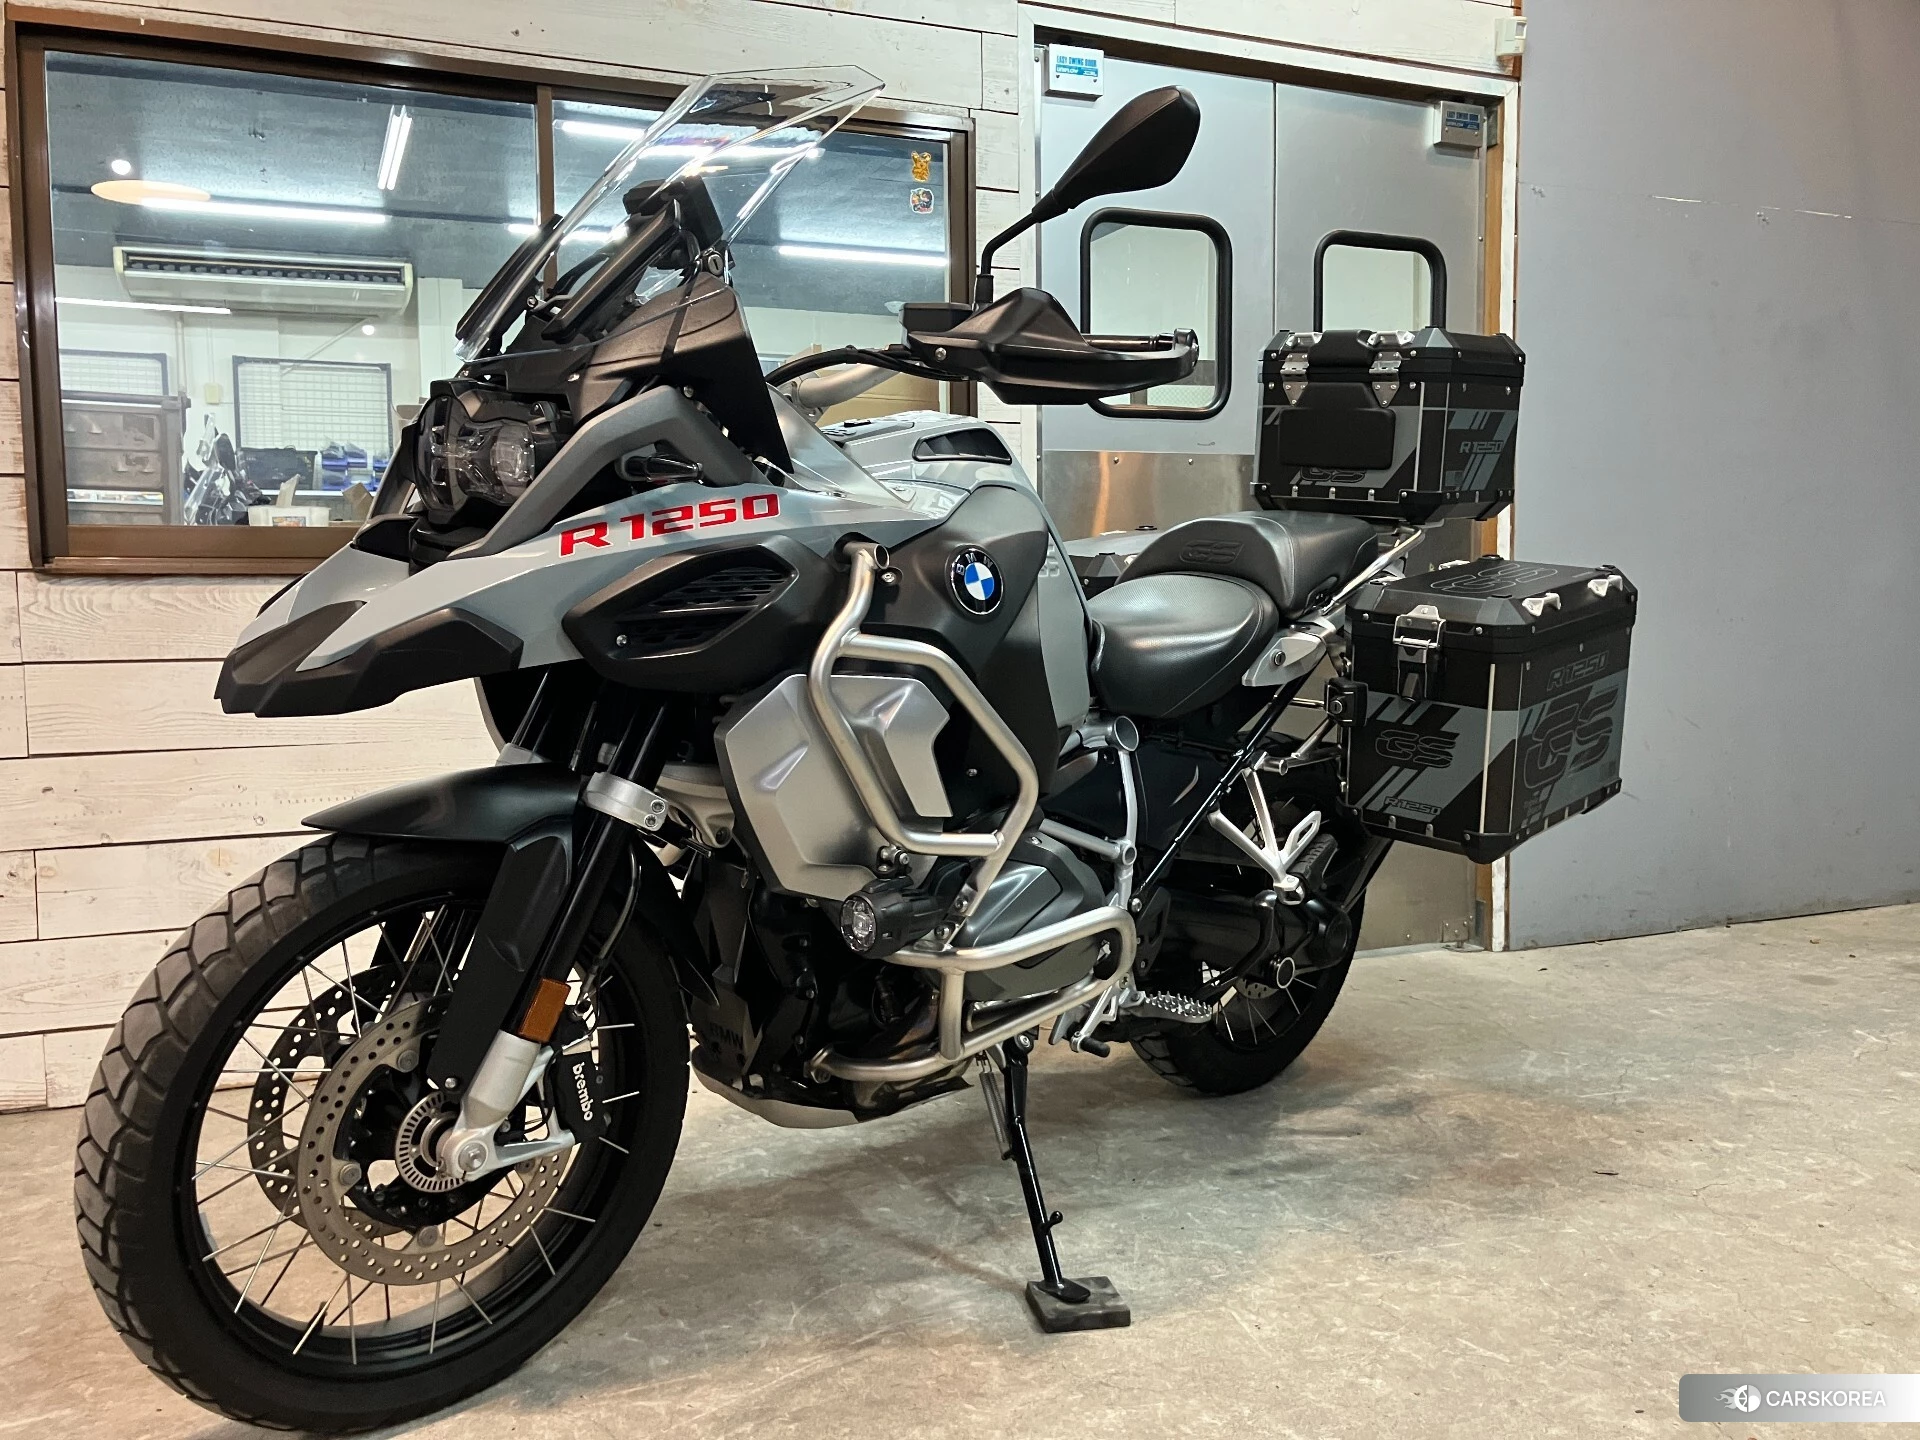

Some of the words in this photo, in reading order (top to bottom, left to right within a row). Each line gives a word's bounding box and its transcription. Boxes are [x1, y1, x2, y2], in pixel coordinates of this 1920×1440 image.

[559, 521, 612, 558] R
[619, 493, 781, 542] 1250
[955, 551, 995, 577] BMW
[1375, 729, 1458, 769] GS
[572, 1061, 594, 1122] brembo
